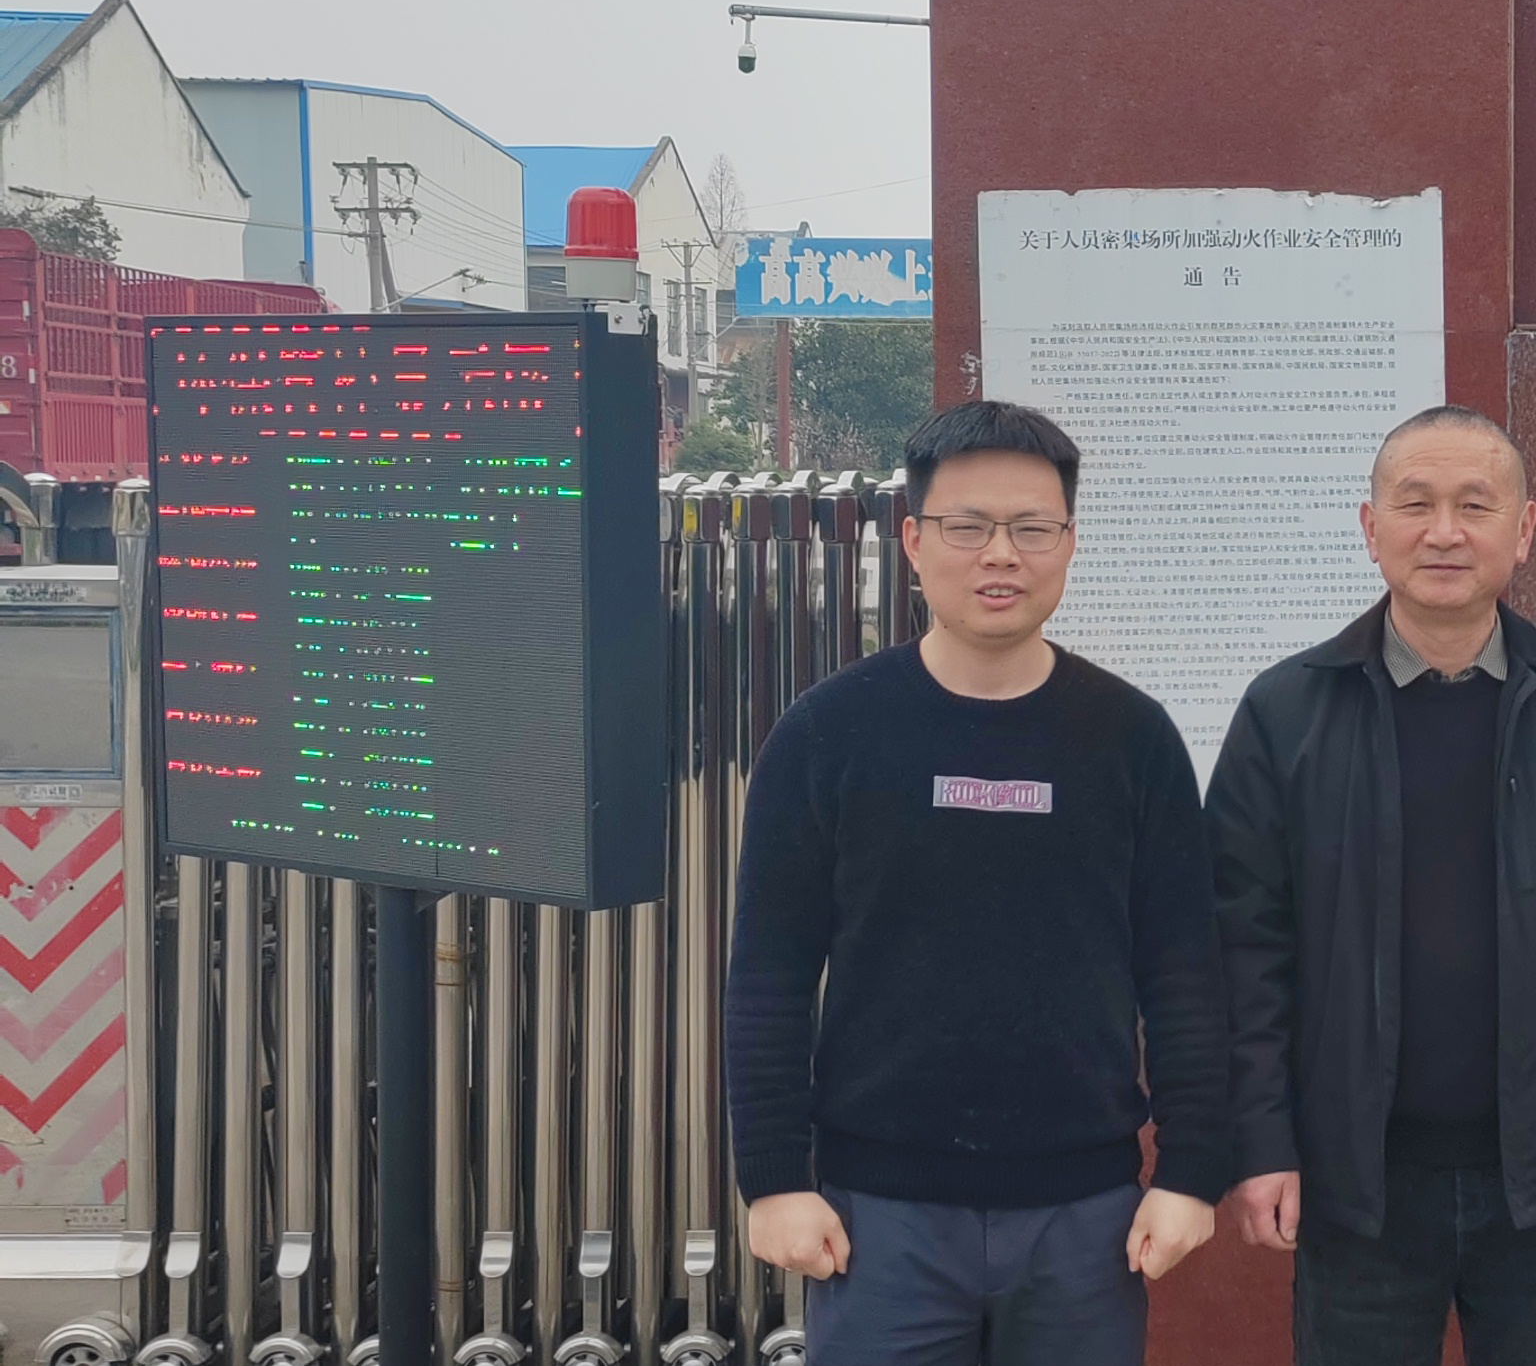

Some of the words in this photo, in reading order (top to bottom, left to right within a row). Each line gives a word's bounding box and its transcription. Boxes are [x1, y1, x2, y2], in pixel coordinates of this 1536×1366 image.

[1019, 228, 1403, 252] 关于人员密集场所加强动火作业安全管理的
[759, 238, 932, 306] 高高兴兴上
[1182, 266, 1243, 288] 通告
